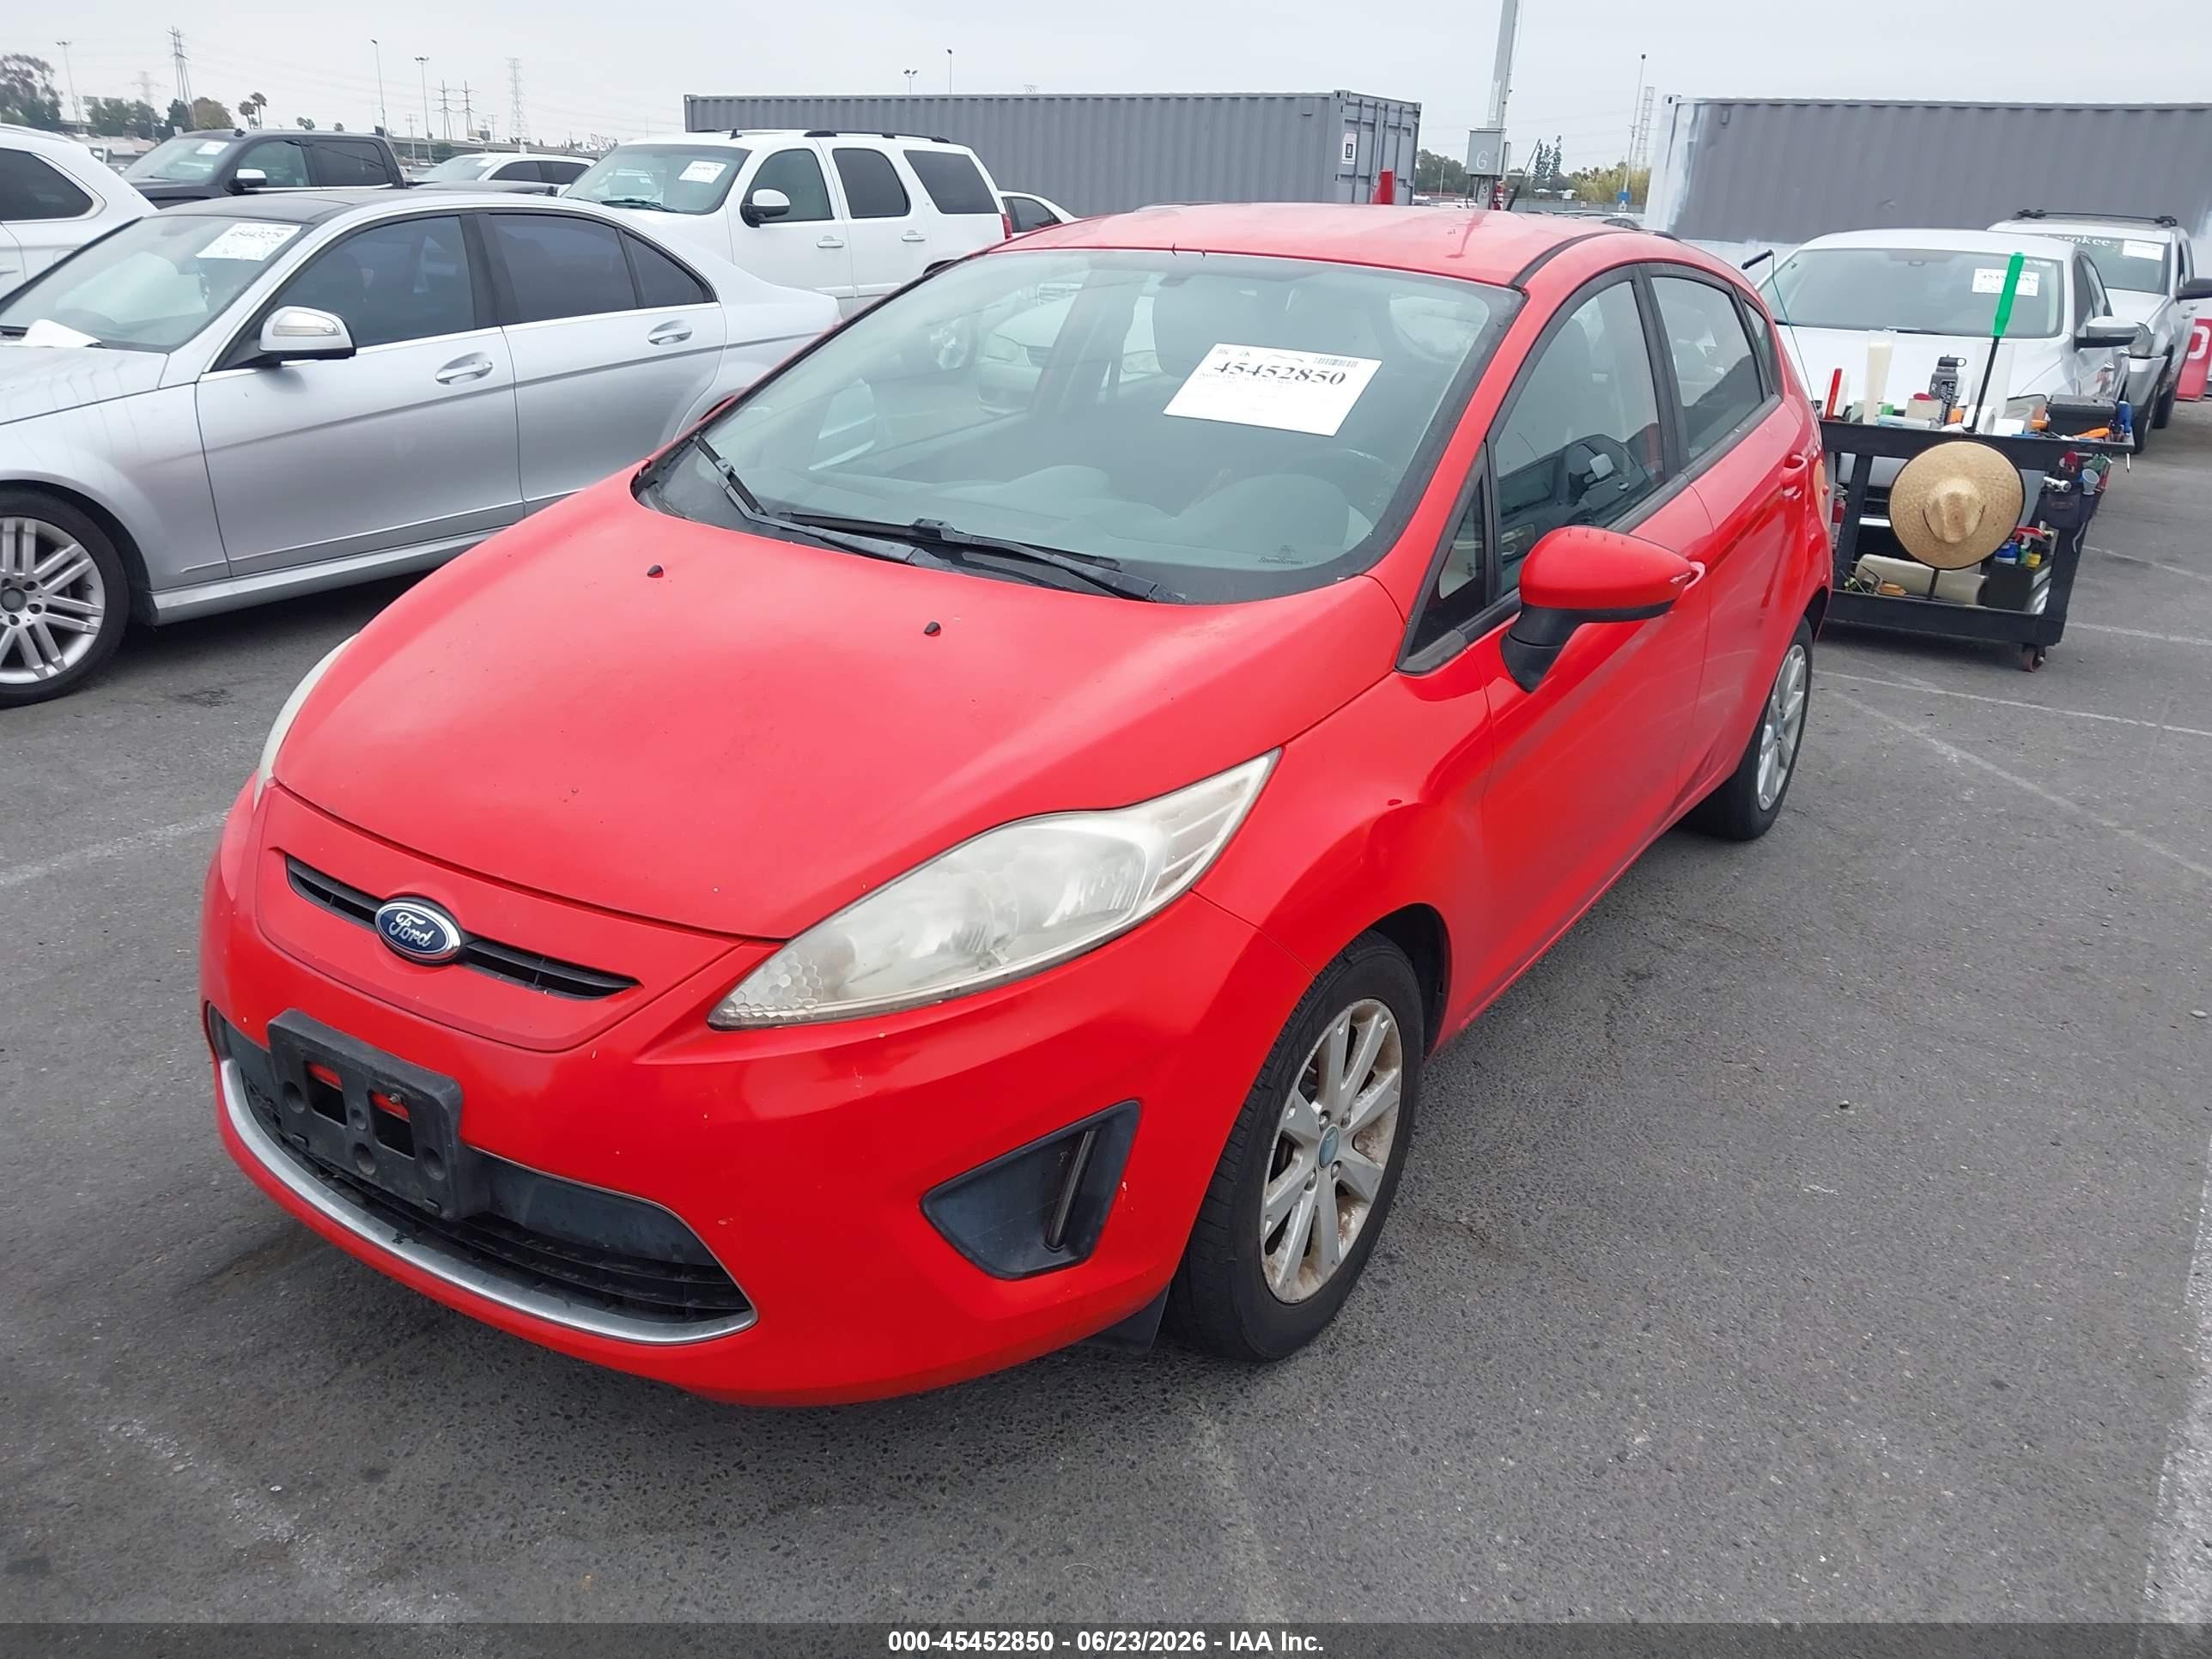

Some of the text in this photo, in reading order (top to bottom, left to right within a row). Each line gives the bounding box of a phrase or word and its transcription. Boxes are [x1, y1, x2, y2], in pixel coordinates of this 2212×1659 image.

[1477, 150, 1488, 169] G
[1213, 360, 1346, 386] 45452850
[389, 911, 434, 947] Ford
